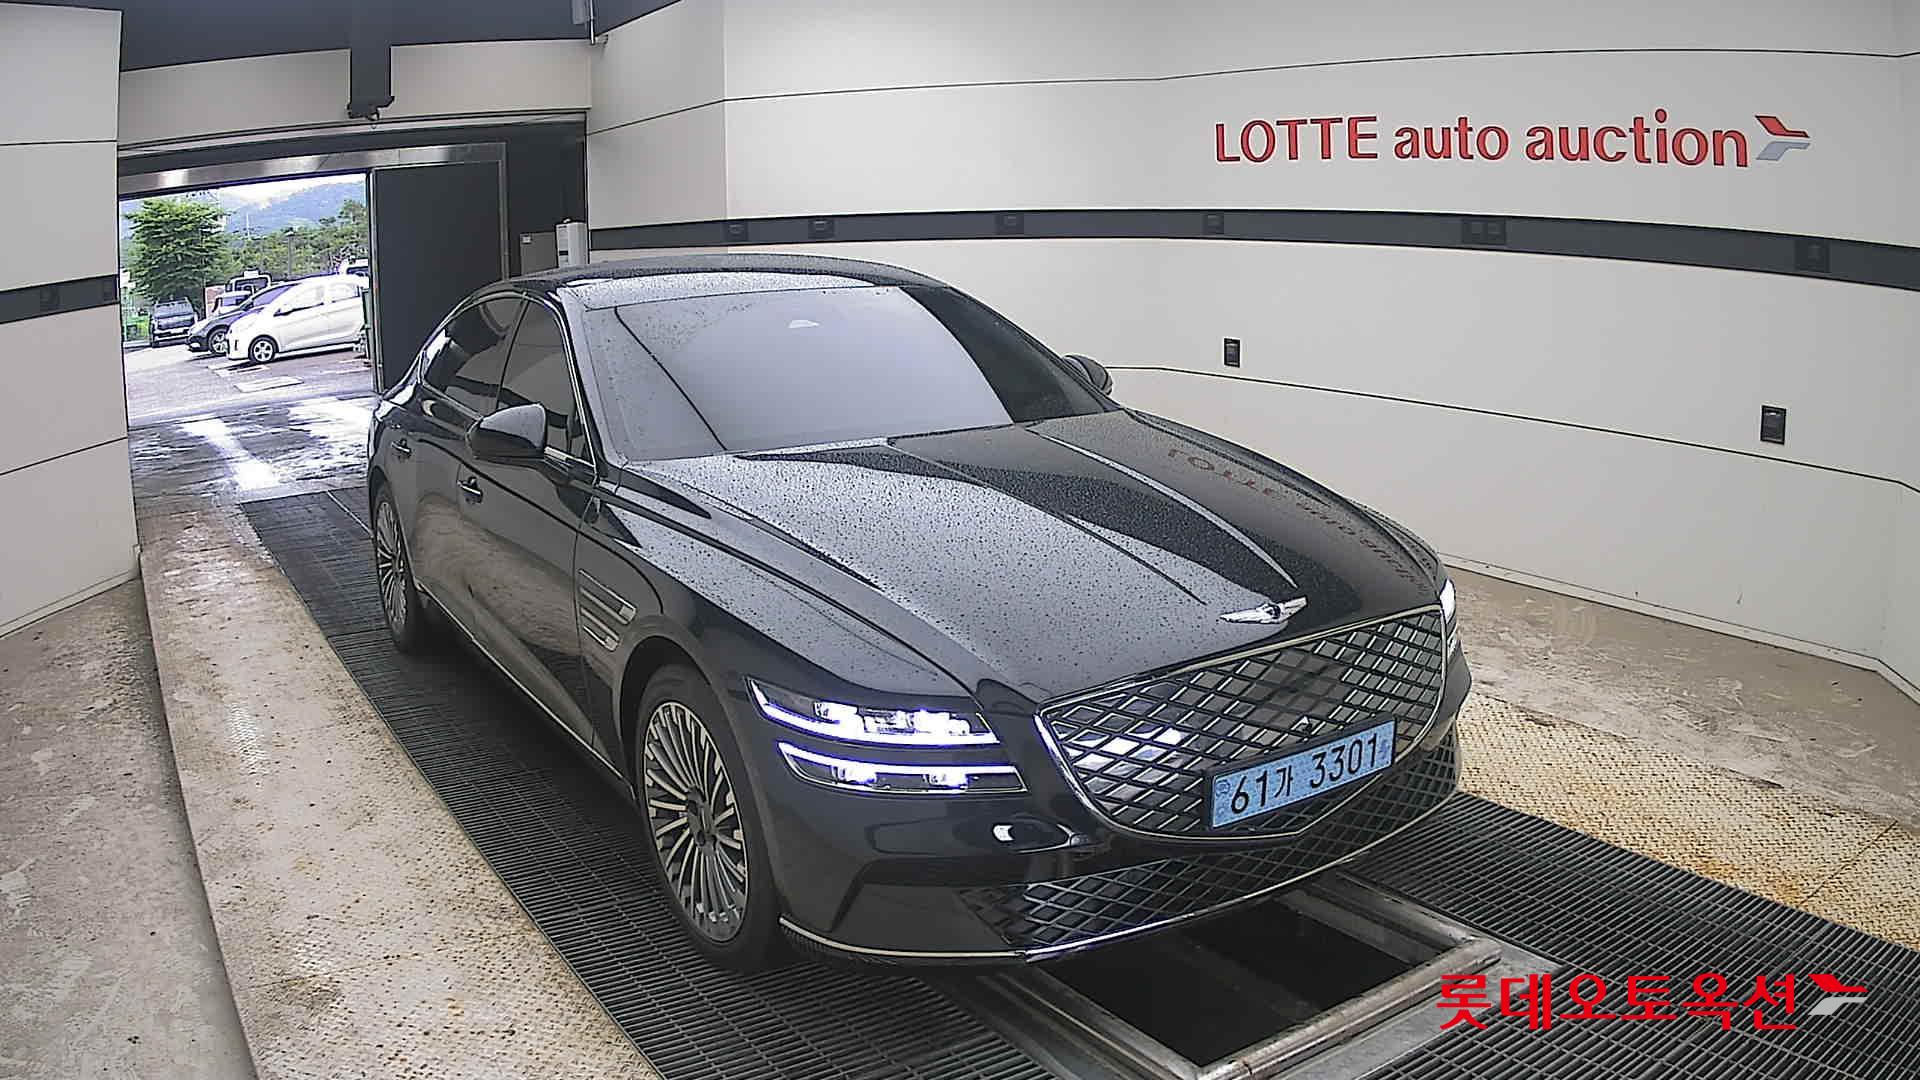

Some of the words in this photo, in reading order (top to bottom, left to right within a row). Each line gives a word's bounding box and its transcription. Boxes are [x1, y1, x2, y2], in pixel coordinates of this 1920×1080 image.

[1214, 115, 1378, 162] LOTTE
[1393, 116, 1509, 161] auto
[1525, 109, 1749, 167] auction
[1230, 765, 1294, 815] 61가
[1309, 732, 1378, 789] 3301
